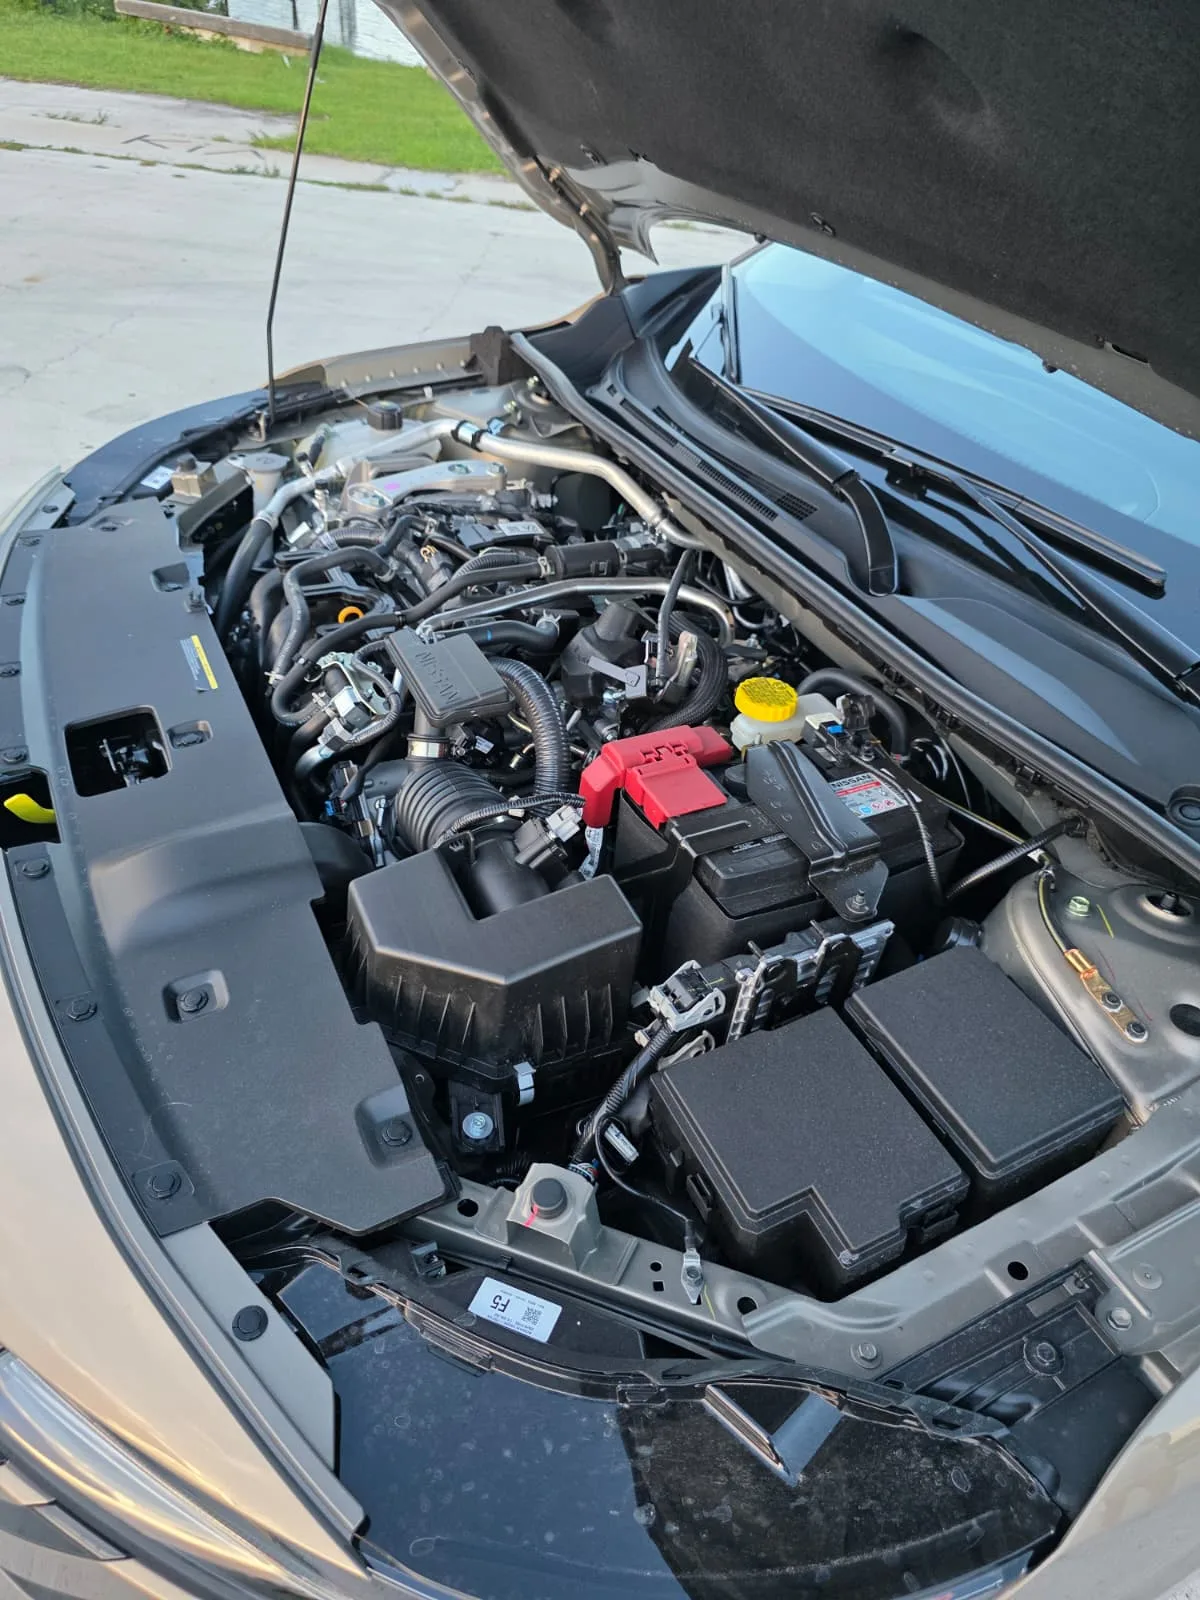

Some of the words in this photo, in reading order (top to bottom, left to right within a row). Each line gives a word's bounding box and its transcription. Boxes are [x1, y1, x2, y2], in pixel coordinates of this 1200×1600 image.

[416, 651, 461, 705] NISSAN
[831, 774, 873, 788] NISSAN
[490, 1294, 511, 1313] F5
